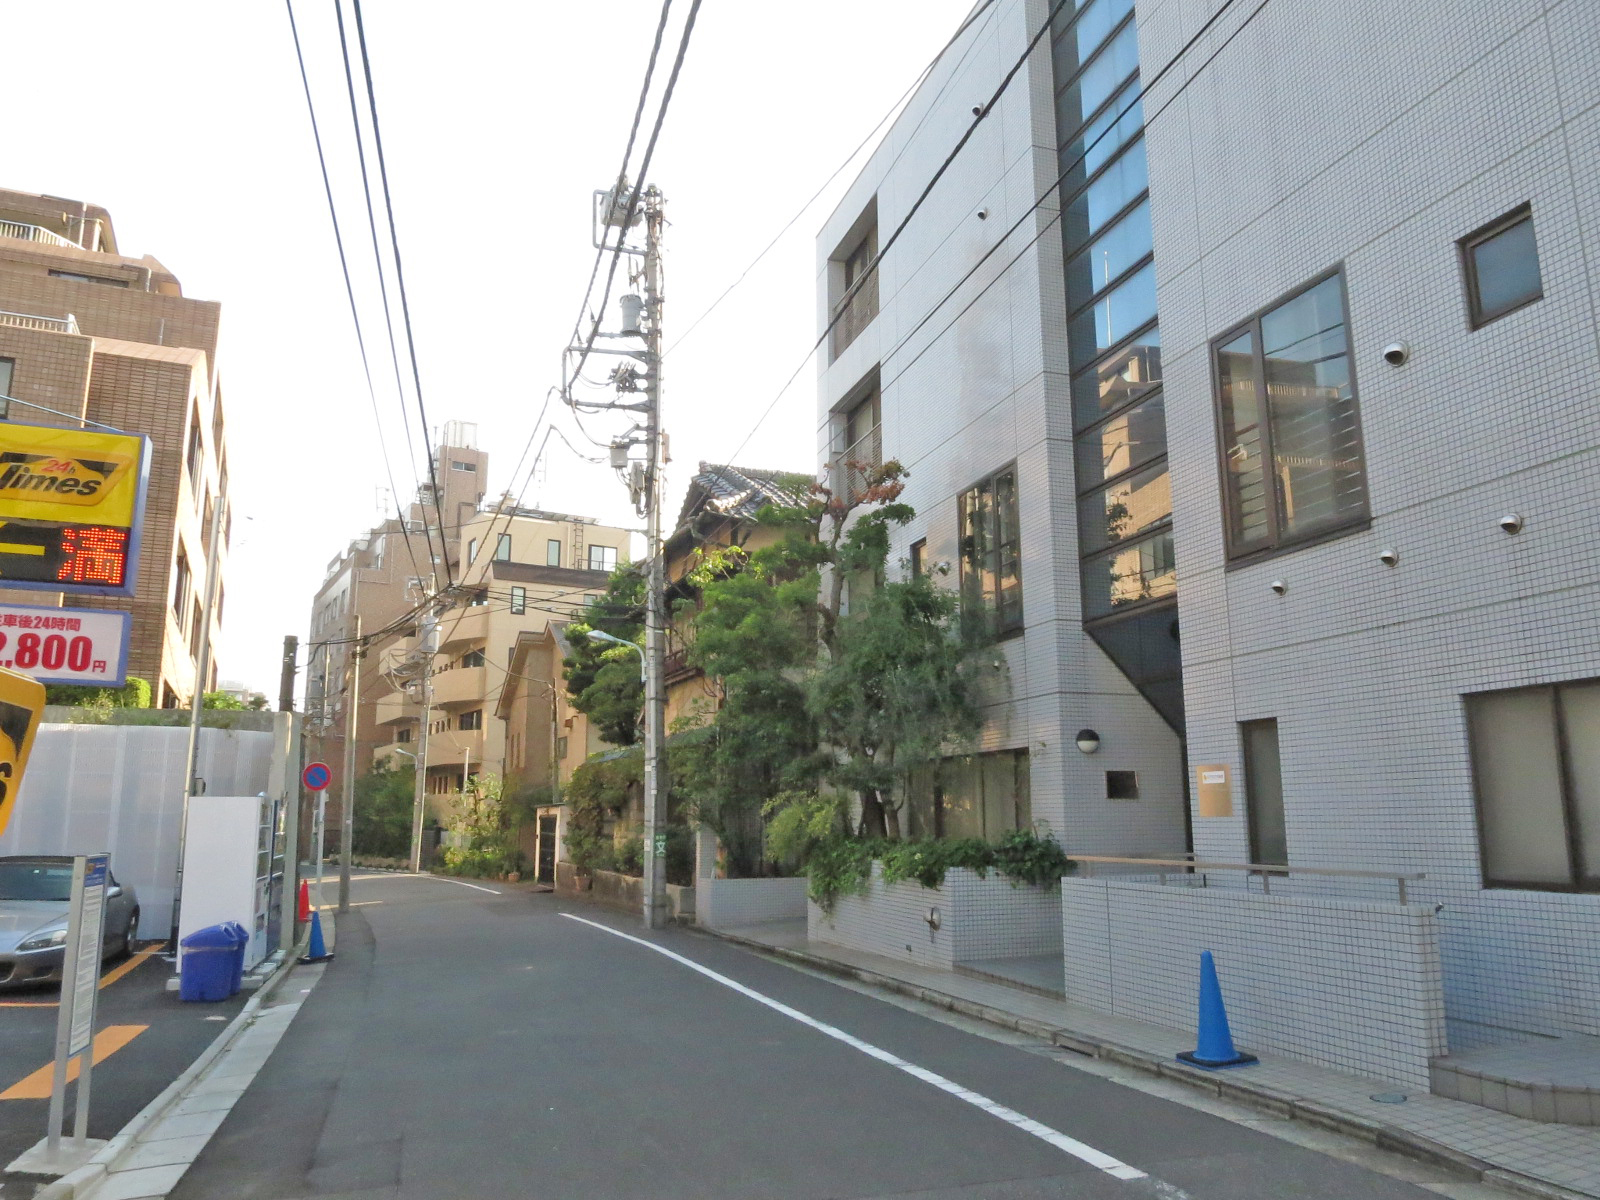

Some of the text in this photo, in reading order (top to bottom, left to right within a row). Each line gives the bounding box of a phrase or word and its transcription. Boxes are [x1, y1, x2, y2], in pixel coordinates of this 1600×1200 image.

[58, 527, 126, 584] 満
[0, 614, 82, 631] 車後24時間
